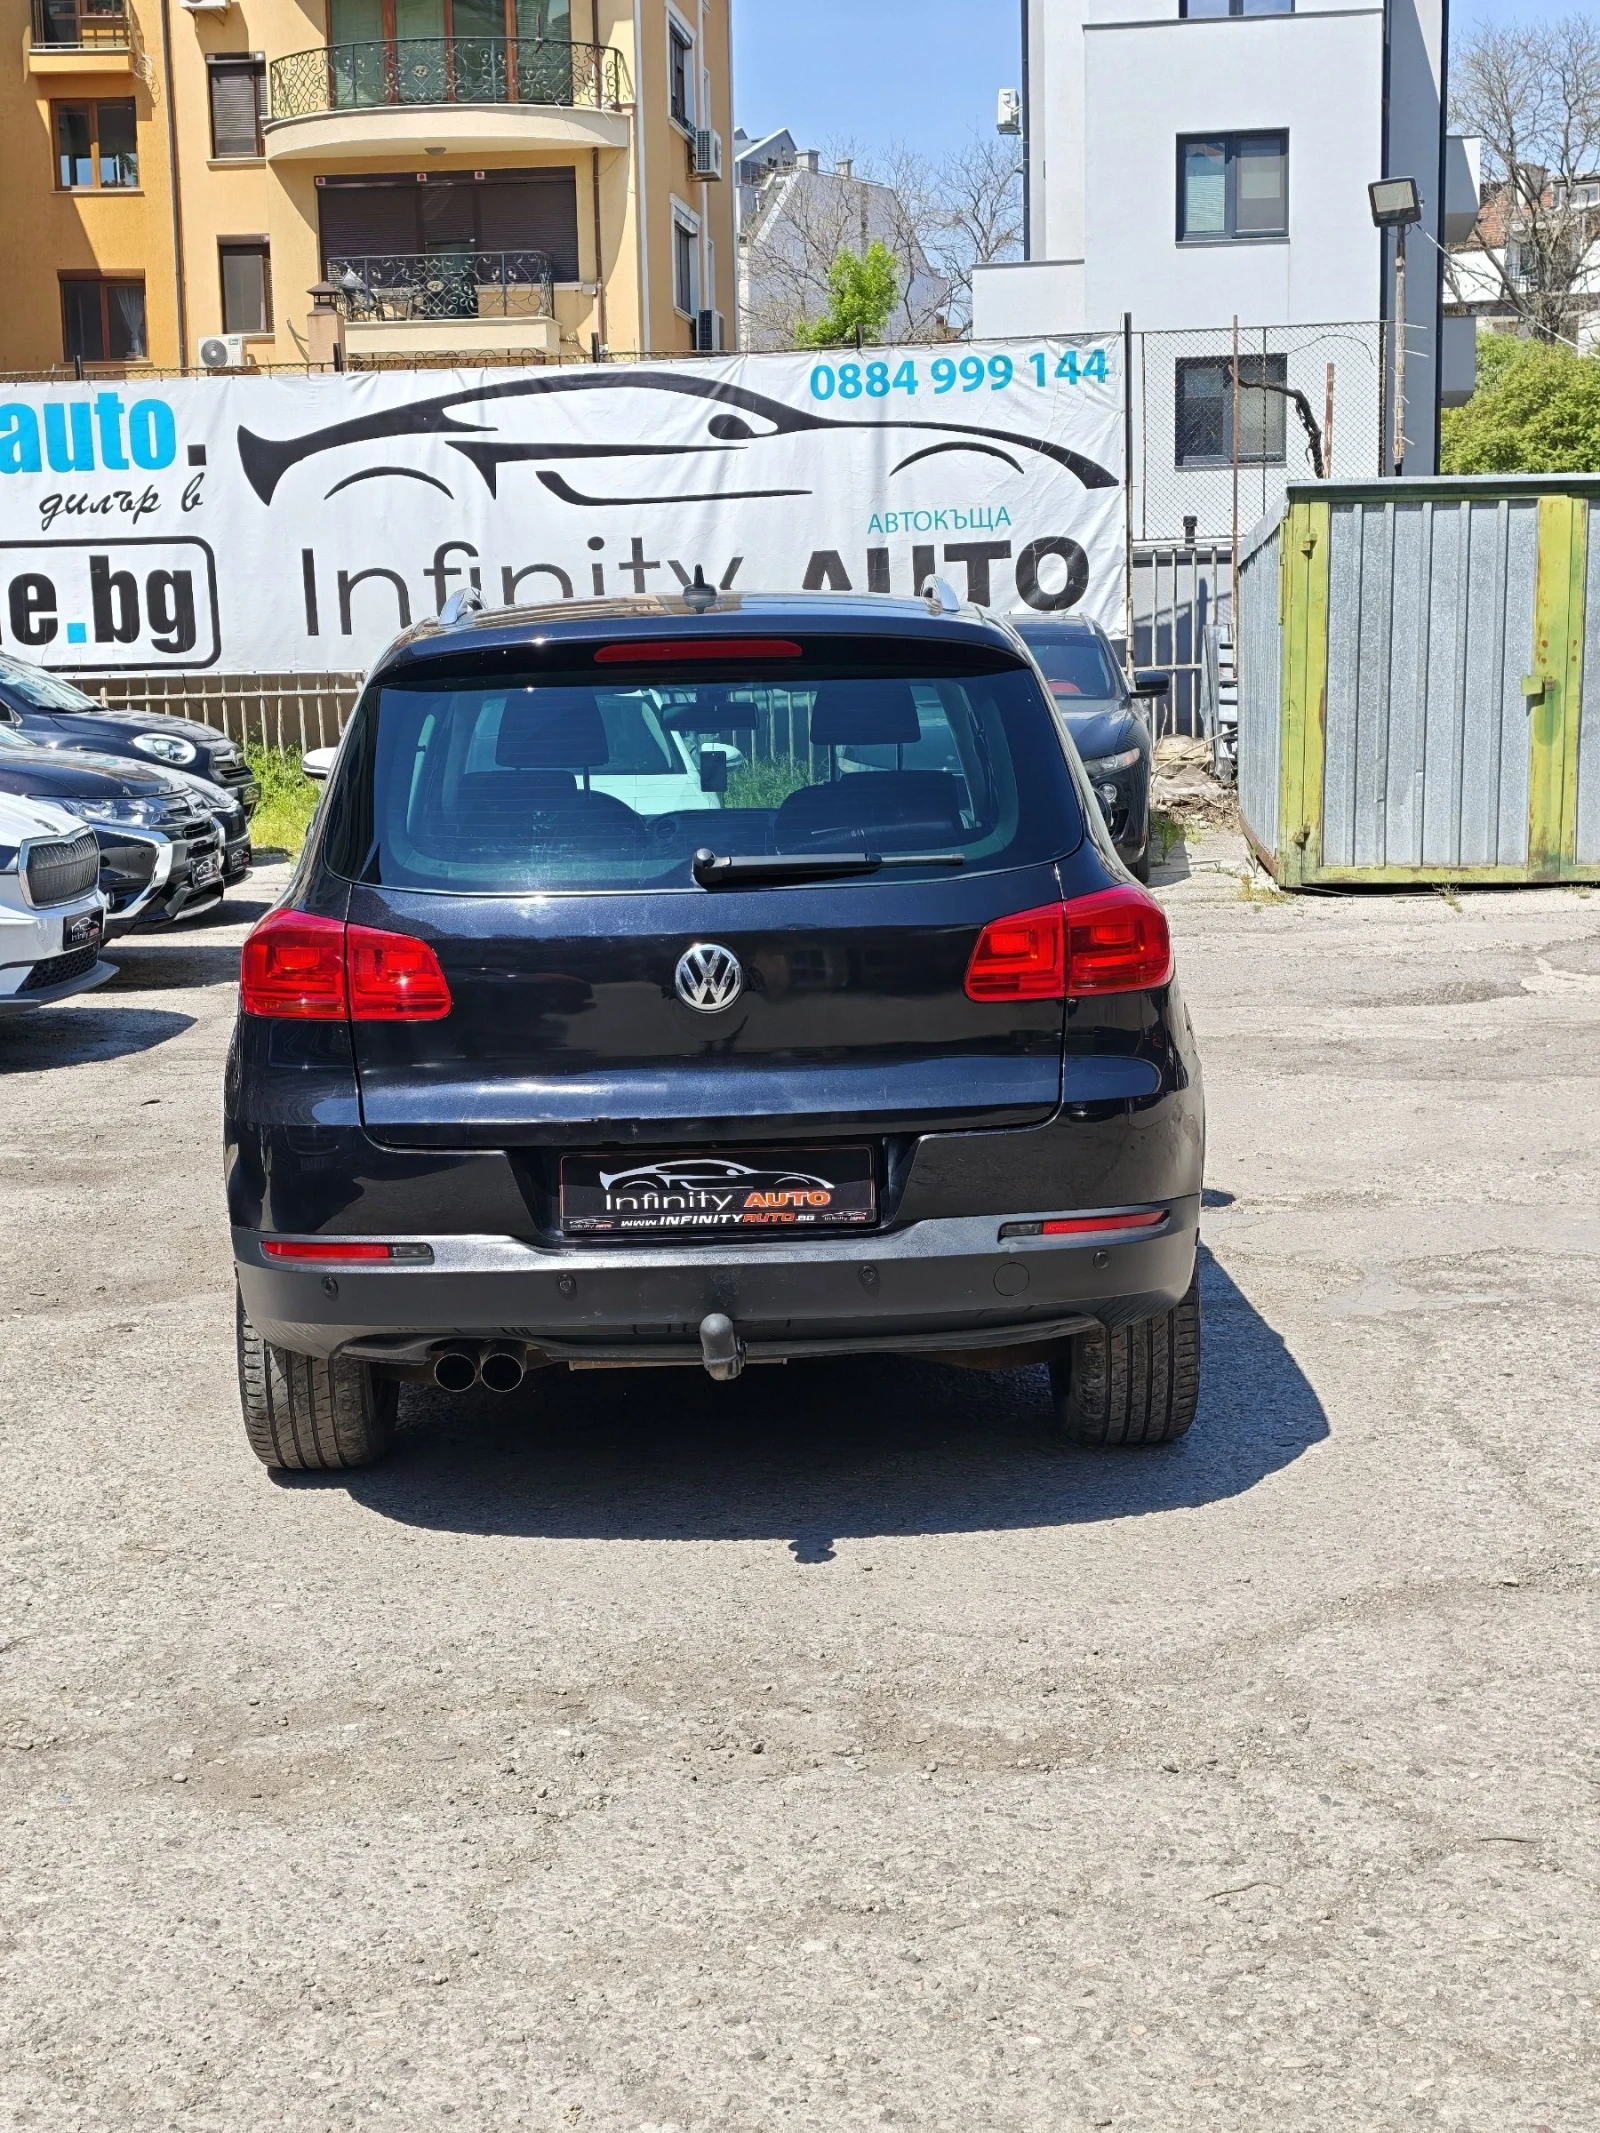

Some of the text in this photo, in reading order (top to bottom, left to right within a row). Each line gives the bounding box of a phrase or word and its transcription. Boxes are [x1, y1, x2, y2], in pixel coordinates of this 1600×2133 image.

[809, 348, 1110, 401] 0884 999 144
[39, 484, 162, 532] дилър
[867, 505, 1013, 535] АВТОКЪЩА
[801, 535, 1090, 612] AUTO
[605, 1190, 831, 1211] Infinity AUTO
